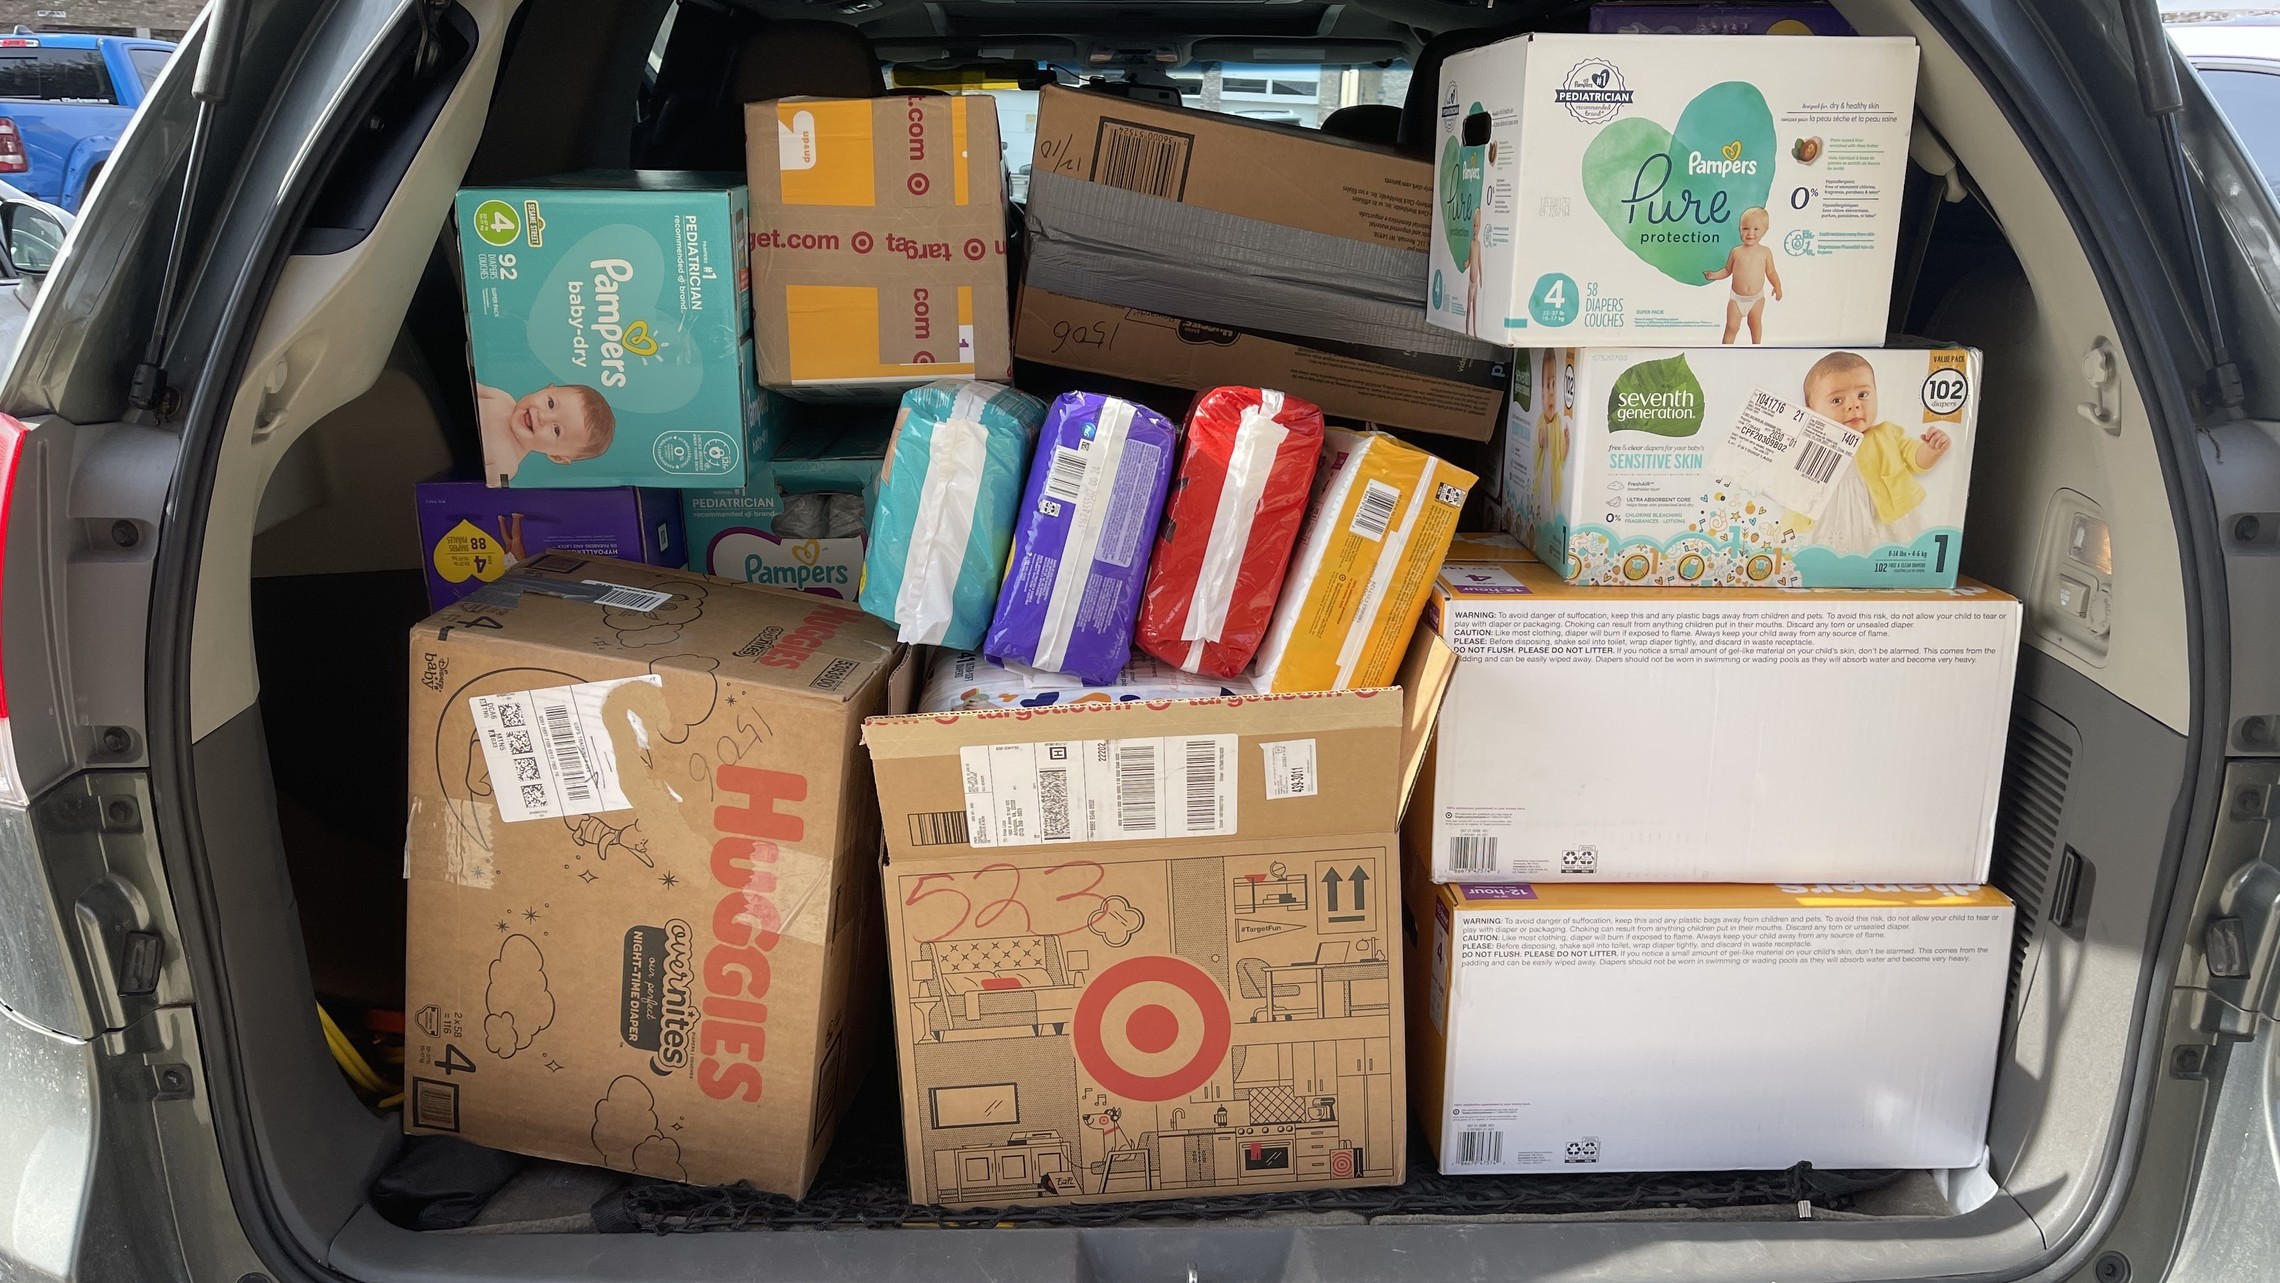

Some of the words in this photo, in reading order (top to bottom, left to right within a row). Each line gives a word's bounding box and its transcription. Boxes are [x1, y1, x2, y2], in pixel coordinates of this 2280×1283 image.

[1560, 92, 1630, 101] PEDIATRICIAN
[1846, 102, 1868, 110] healthy
[1118, 126, 1142, 139] 51524
[1144, 132, 1174, 144] 36000
[1462, 160, 1480, 180] Pampers
[1688, 150, 1757, 178] Pampers
[1621, 152, 1731, 224] Pure
[493, 211, 515, 232] 4
[528, 204, 536, 222] SESAME
[529, 224, 538, 244] STREET
[1640, 231, 1720, 244] protection
[674, 215, 684, 274] recommended
[479, 254, 488, 280] COUCHES
[488, 254, 496, 280] DIAPERS
[498, 254, 517, 280] 92
[685, 215, 703, 310] PEDIATRICIAN
[704, 266, 717, 280] #1
[678, 286, 686, 310] brand
[1544, 279, 1565, 308] 4
[1586, 283, 1598, 296] 58
[1586, 298, 1623, 312] DIAPERS
[567, 281, 587, 368] baby-dry
[590, 258, 634, 388] Pampers
[1585, 314, 1624, 327] COUCHES
[1618, 390, 1694, 407] seventh
[1929, 380, 1963, 399] 102
[1756, 393, 1786, 414] 1041716
[1793, 410, 1805, 422] 21
[1931, 400, 1957, 408] diapers
[1769, 430, 1785, 442] 2030
[1842, 432, 1860, 448] 1401
[1610, 454, 1672, 469] SENSITIVE
[1674, 454, 1703, 469] SKIN
[692, 498, 774, 509] PEDIATRICIAN
[470, 538, 486, 550] 88
[1935, 534, 1948, 572] 1
[474, 557, 486, 573] 4
[744, 554, 848, 589] Pampers
[1875, 563, 1888, 572] 102
[456, 616, 503, 629] 4
[1530, 611, 1555, 620] danger
[1566, 611, 1608, 620] suffocation,
[1610, 611, 1629, 620] keep
[1676, 611, 1700, 620] plastic
[1701, 612, 1720, 620] bags
[1806, 612, 1822, 621] pets.
[1872, 612, 1887, 620] risk,
[957, 652, 976, 663] 41
[421, 652, 437, 690] baby
[1054, 749, 1063, 757] H
[1098, 743, 1107, 762] 22202
[1291, 766, 1304, 794] 439-3011
[905, 860, 1109, 943] 523
[697, 764, 807, 1103] HUGGIES
[1241, 924, 1282, 934] #TargetFun
[1520, 942, 1556, 951] disposing,
[1611, 941, 1630, 949] toilet,
[1651, 941, 1674, 950] diaper
[1676, 941, 1698, 950] tightly,
[1774, 940, 1812, 949] receptacle.
[631, 931, 643, 998] NIGHT-TIME
[641, 980, 656, 1020] perfect
[663, 925, 689, 1064] overnites
[629, 1000, 640, 1041] DIAPER
[434, 1044, 476, 1075] 4
